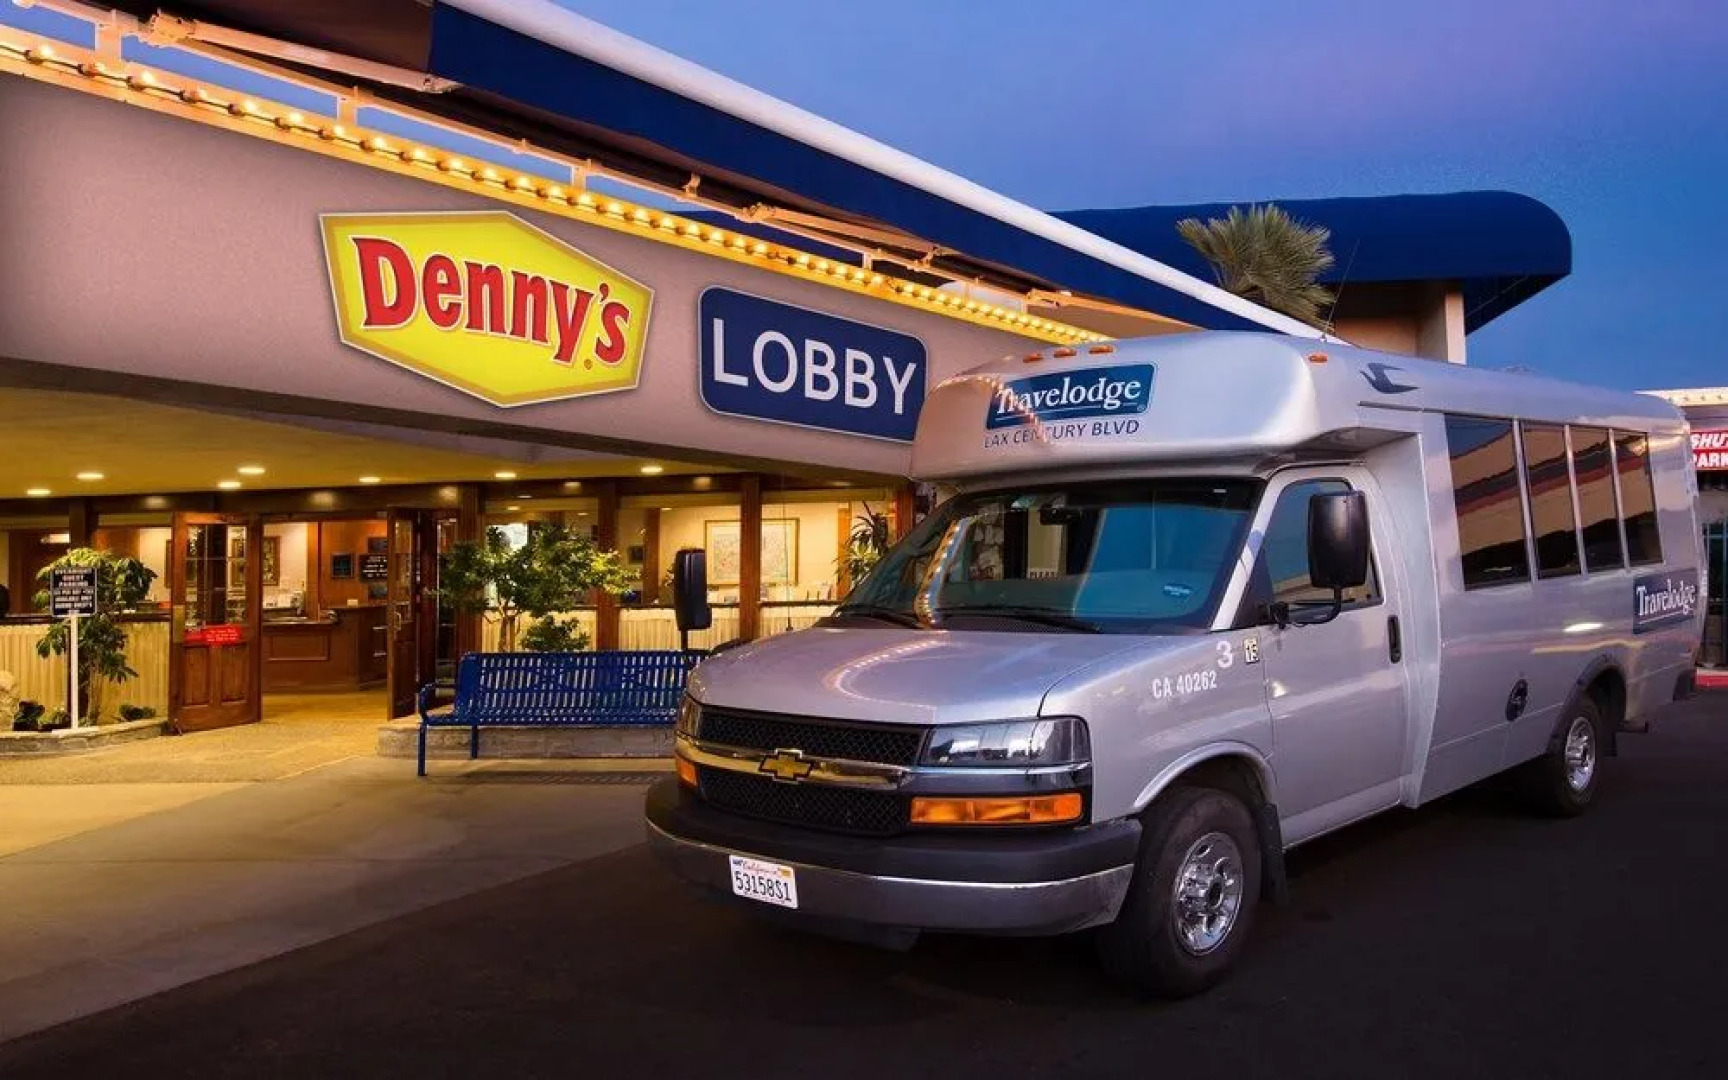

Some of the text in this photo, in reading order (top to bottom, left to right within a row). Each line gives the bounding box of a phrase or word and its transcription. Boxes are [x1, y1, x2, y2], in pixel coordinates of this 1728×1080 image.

[350, 236, 630, 366] Denny's
[713, 318, 917, 415] LOBBY
[995, 376, 1141, 414] Travelodge
[984, 433, 1009, 448] LAX
[1091, 419, 1140, 437] BLVD
[1636, 578, 1696, 615] Travelodge
[1216, 640, 1233, 668] 3
[1152, 669, 1217, 698] CA 40262
